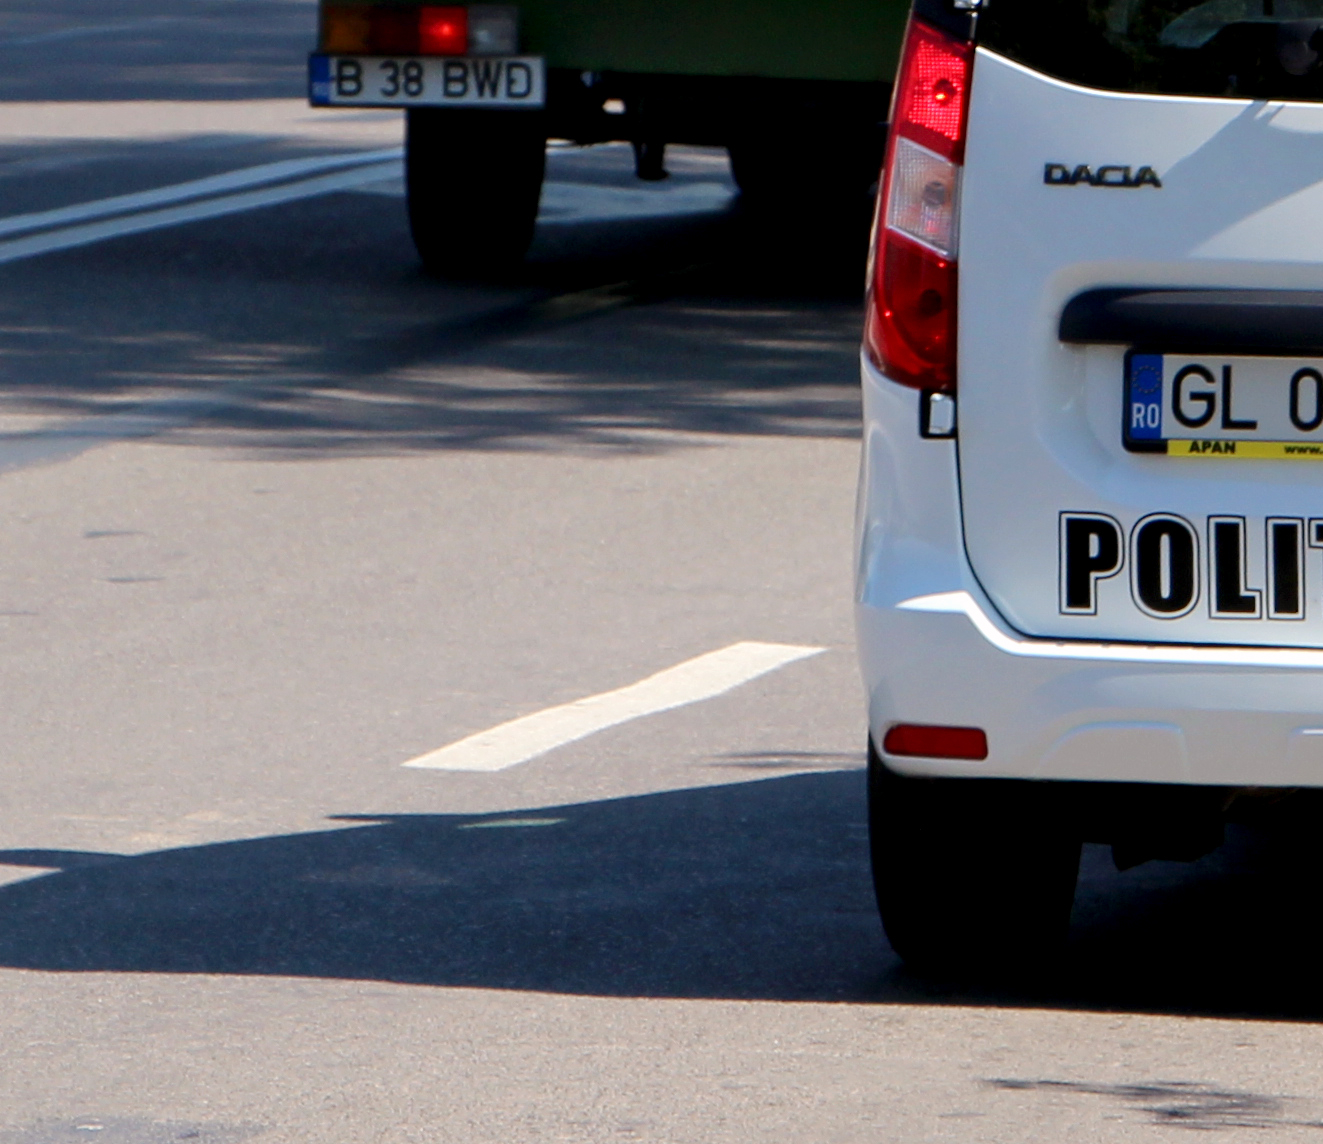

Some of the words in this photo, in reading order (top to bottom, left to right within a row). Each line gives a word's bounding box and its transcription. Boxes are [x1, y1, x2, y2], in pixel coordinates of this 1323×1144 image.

[336, 59, 362, 96] B
[379, 60, 423, 97] 38
[443, 60, 532, 98] BWD
[1043, 162, 1162, 188] DACIA
[1132, 403, 1160, 428] RO
[1172, 364, 1258, 430] GL
[1189, 441, 1236, 454] APAN
